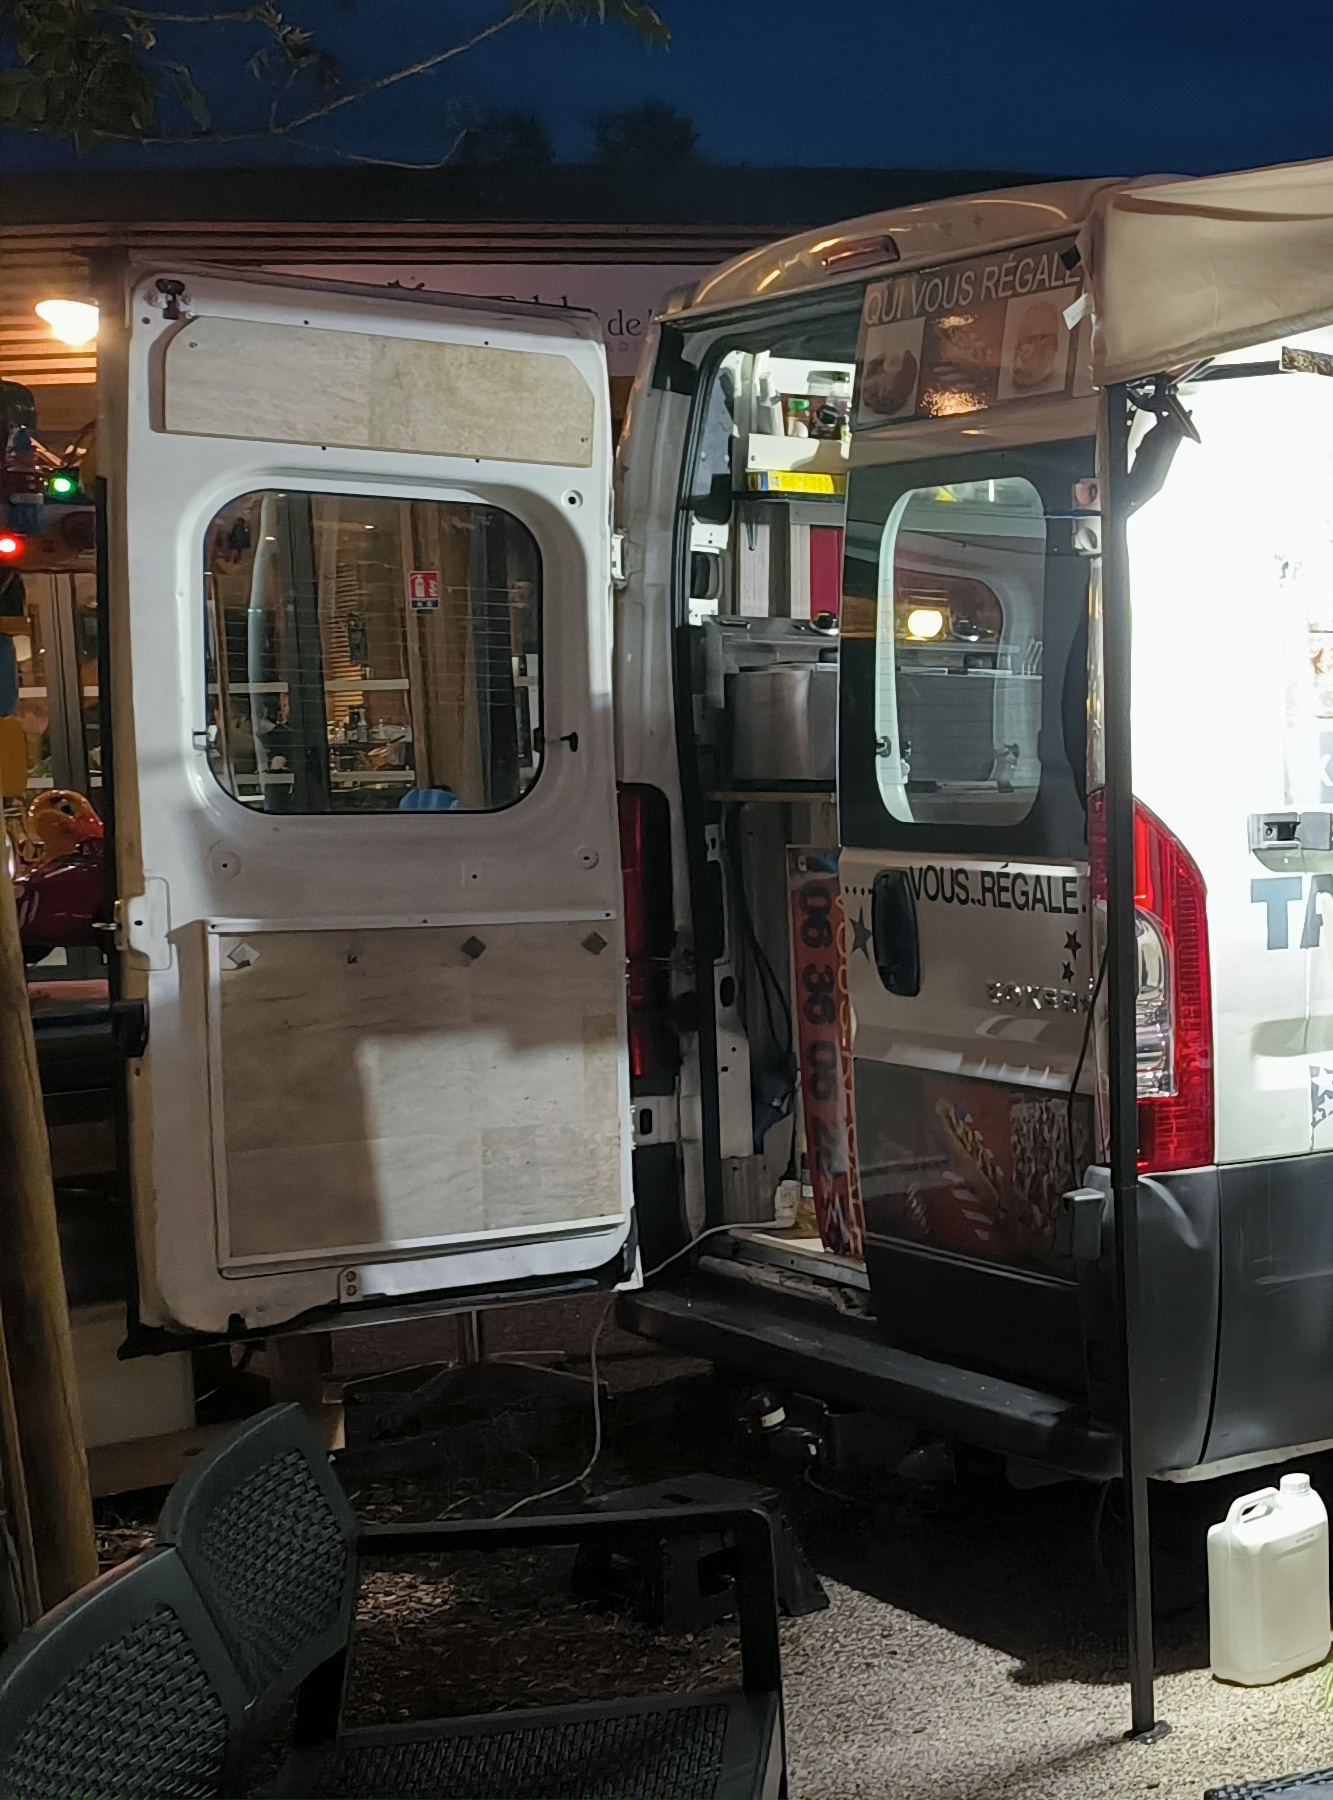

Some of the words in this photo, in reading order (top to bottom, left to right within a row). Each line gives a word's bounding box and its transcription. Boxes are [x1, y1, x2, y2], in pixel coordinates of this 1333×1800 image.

[607, 308, 642, 337] de
[864, 279, 904, 325] QUI
[911, 269, 975, 316] VOUS
[798, 884, 836, 950] 06
[802, 961, 840, 1027] 36
